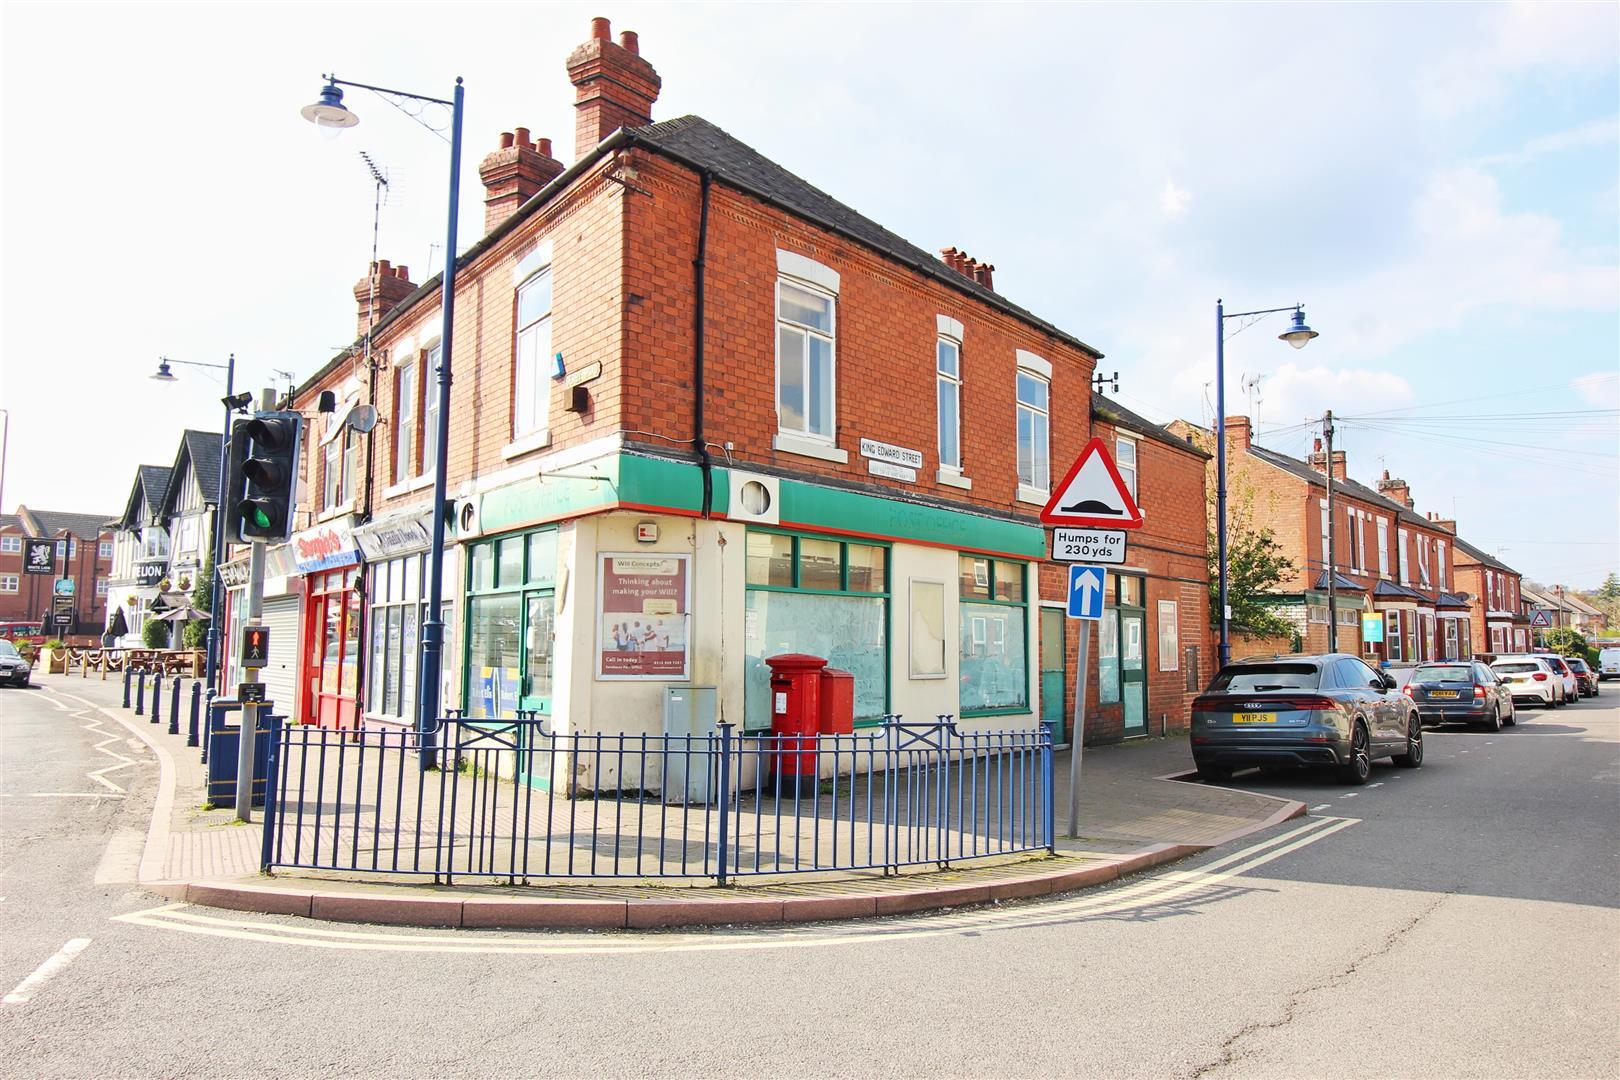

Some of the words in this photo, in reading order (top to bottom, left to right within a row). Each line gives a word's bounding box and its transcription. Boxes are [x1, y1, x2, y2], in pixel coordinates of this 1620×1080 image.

[862, 443, 875, 454] KING
[878, 446, 899, 459] EDWARD
[902, 452, 921, 464] STREET
[1058, 532, 1099, 544] Humps
[1104, 534, 1121, 545] for
[1065, 544, 1090, 555] 230
[1092, 547, 1113, 557] yds
[618, 578, 649, 587] Thinking
[612, 588, 639, 597] making
[658, 588, 678, 596] Will?
